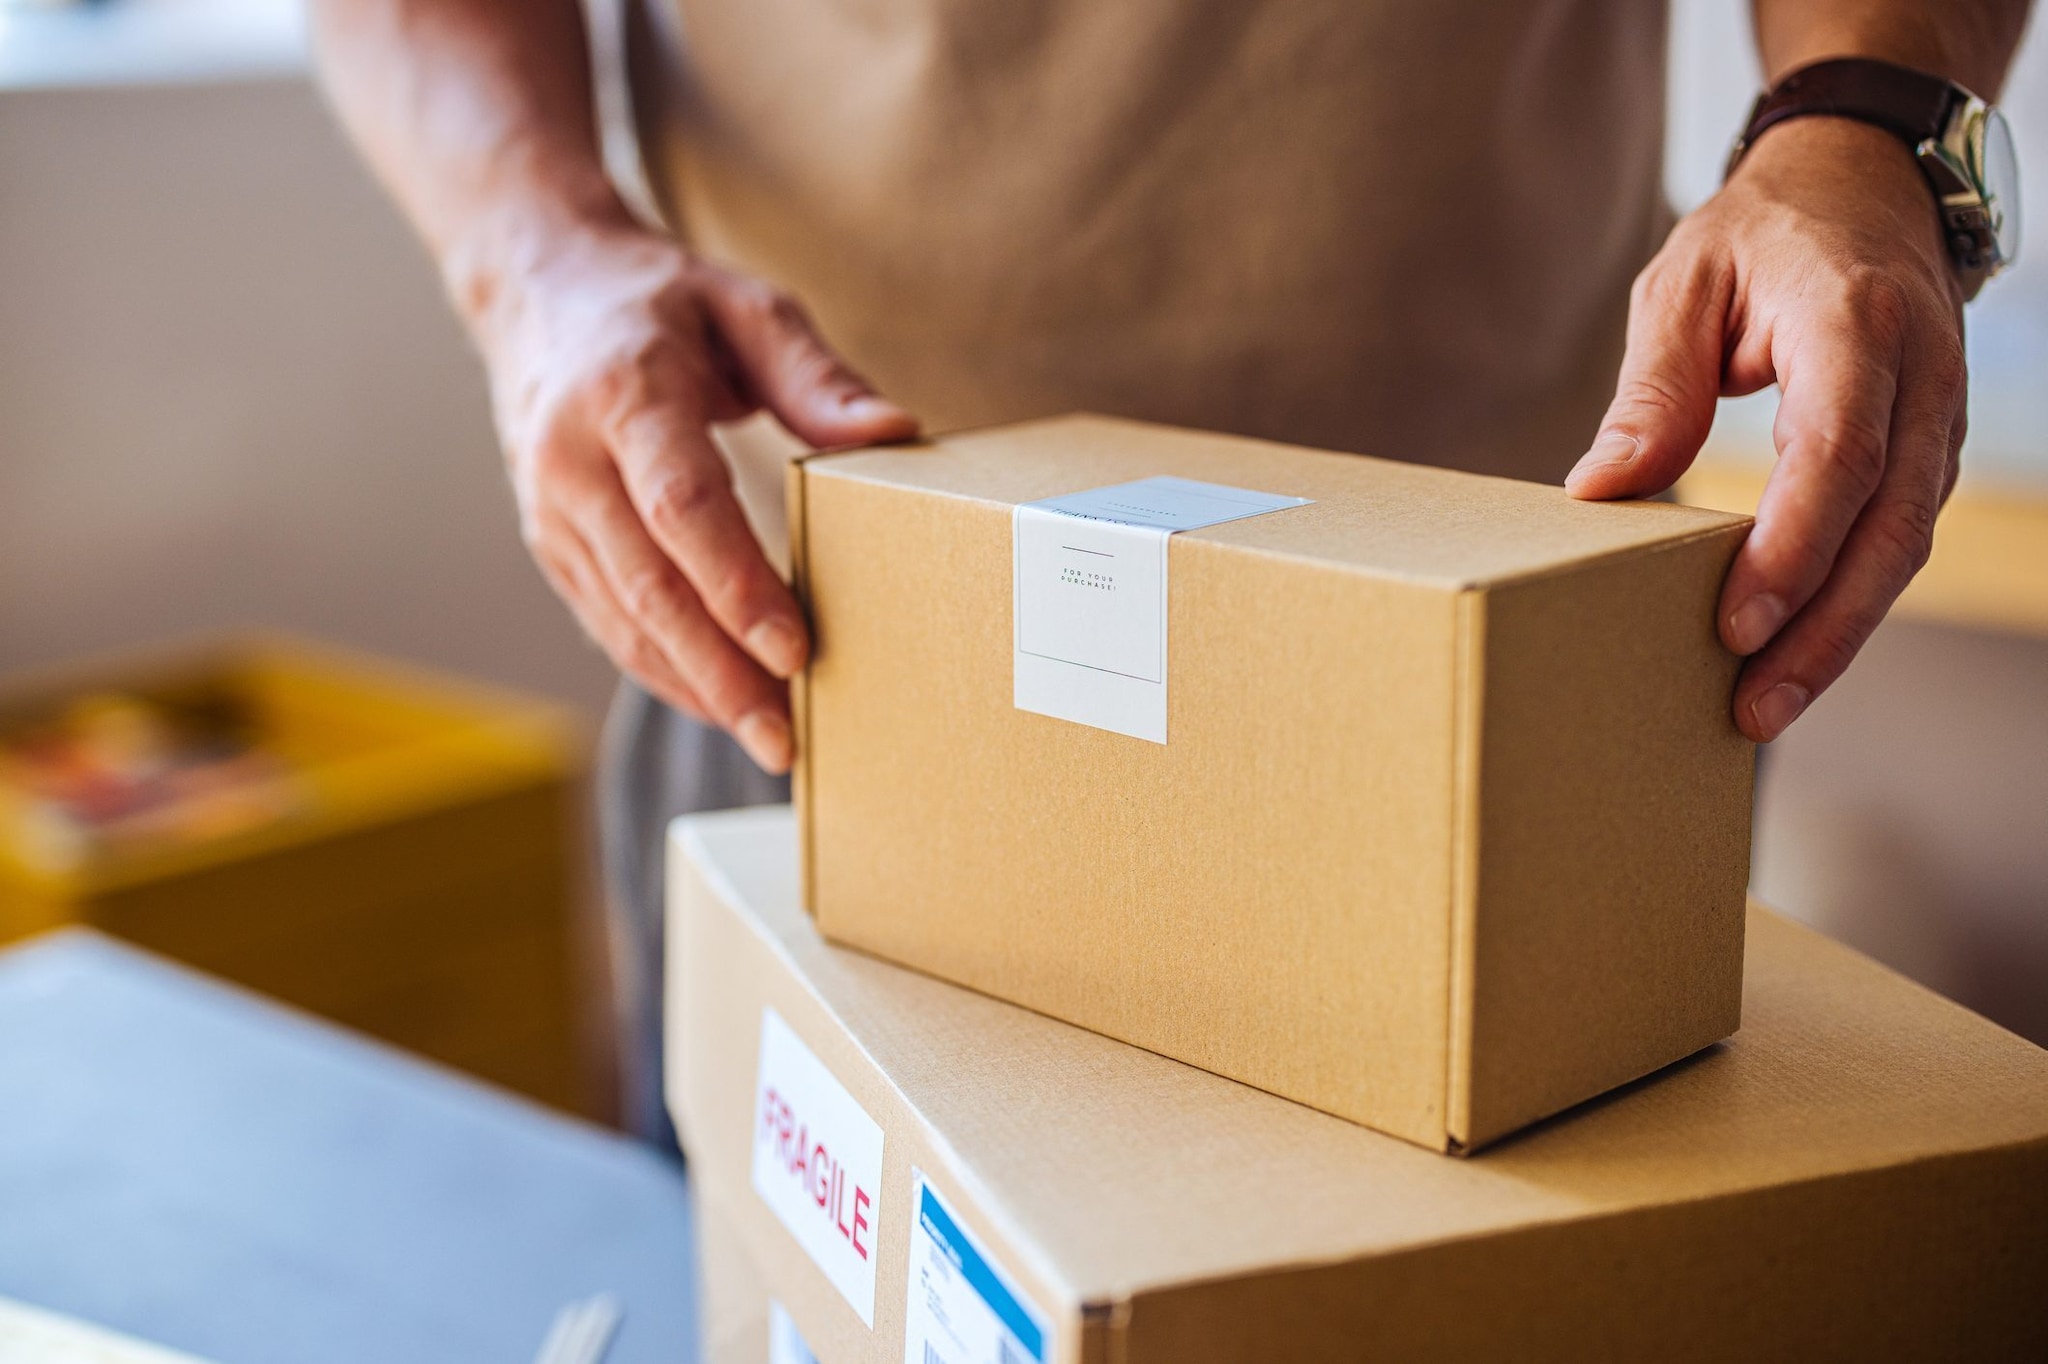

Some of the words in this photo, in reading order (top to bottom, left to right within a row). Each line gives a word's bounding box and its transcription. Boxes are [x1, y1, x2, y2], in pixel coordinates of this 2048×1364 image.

[1060, 575, 1116, 591] PURCHASE!
[1063, 568, 1081, 576] FOR
[1087, 573, 1113, 582] YOUR
[762, 1087, 870, 1261] FRAGILE
